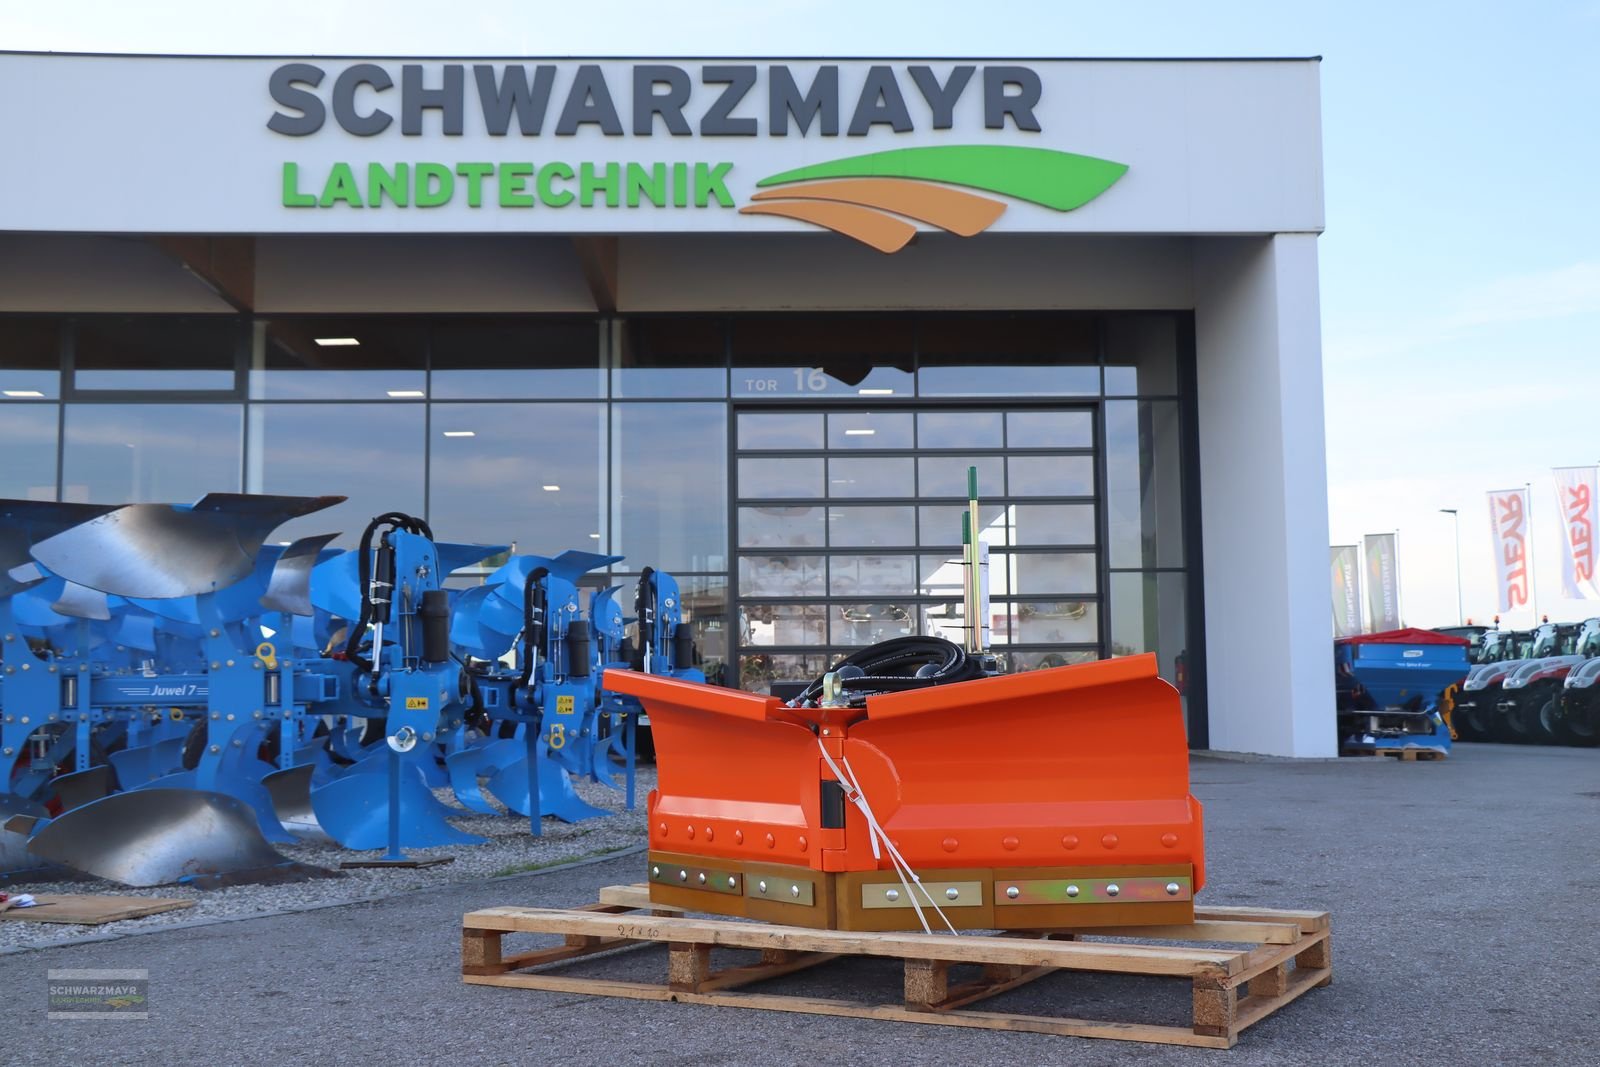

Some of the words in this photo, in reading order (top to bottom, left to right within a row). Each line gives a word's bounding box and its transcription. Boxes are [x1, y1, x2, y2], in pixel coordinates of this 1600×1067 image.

[266, 62, 1043, 137] SCHWARZMAYR
[282, 161, 736, 208] LANDTECHNIK
[744, 379, 778, 391] TOR
[793, 367, 828, 392] 16
[150, 684, 187, 696] Juwel
[188, 684, 198, 696] 7
